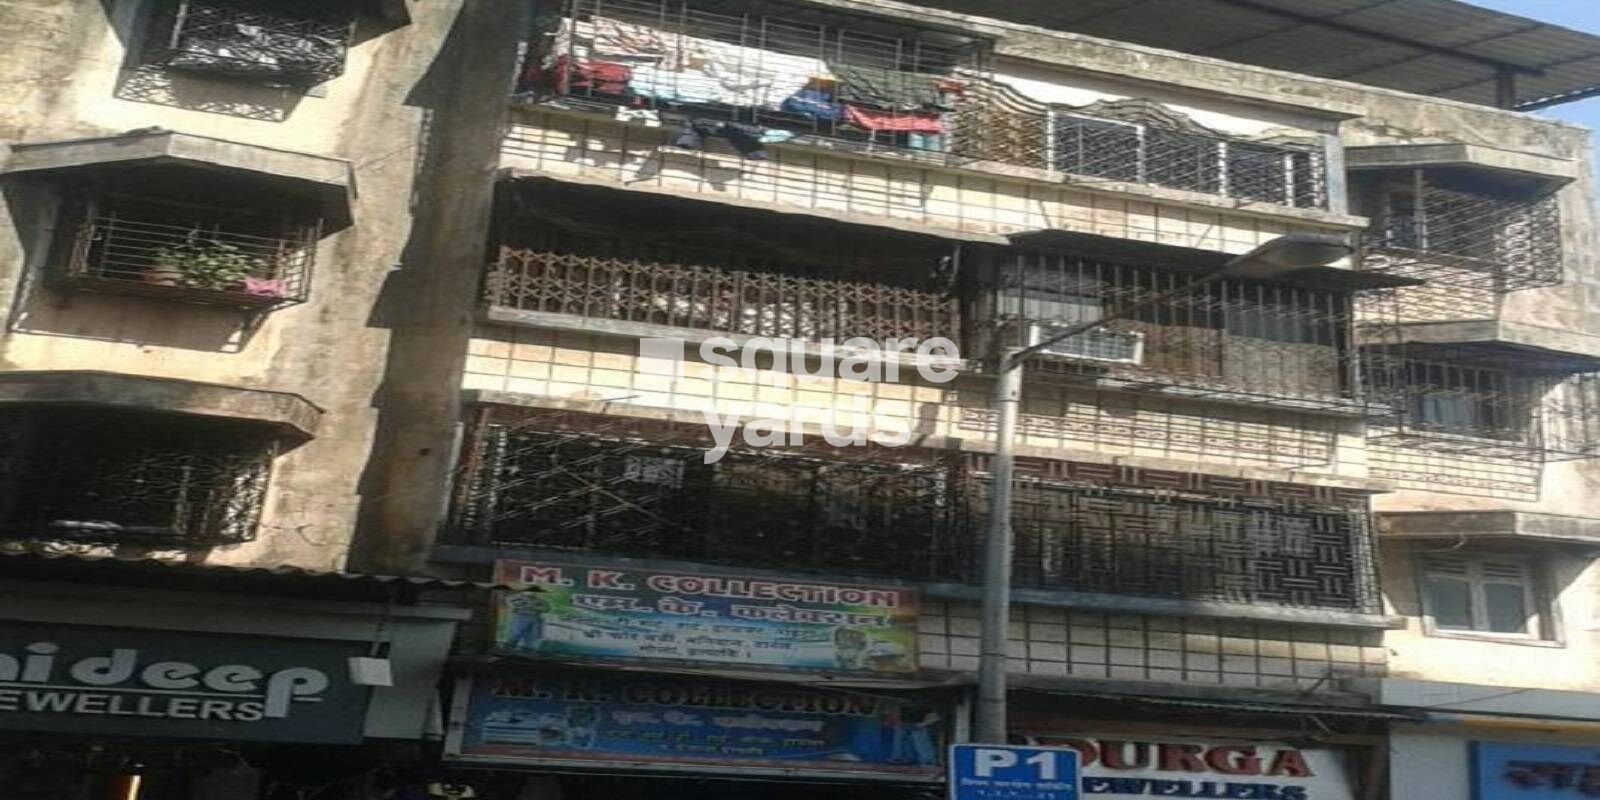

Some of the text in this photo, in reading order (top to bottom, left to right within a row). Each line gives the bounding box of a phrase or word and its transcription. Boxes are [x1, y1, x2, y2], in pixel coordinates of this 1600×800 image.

[521, 566, 899, 608] M. K. COLLECTION
[975, 749, 1057, 780] P1
